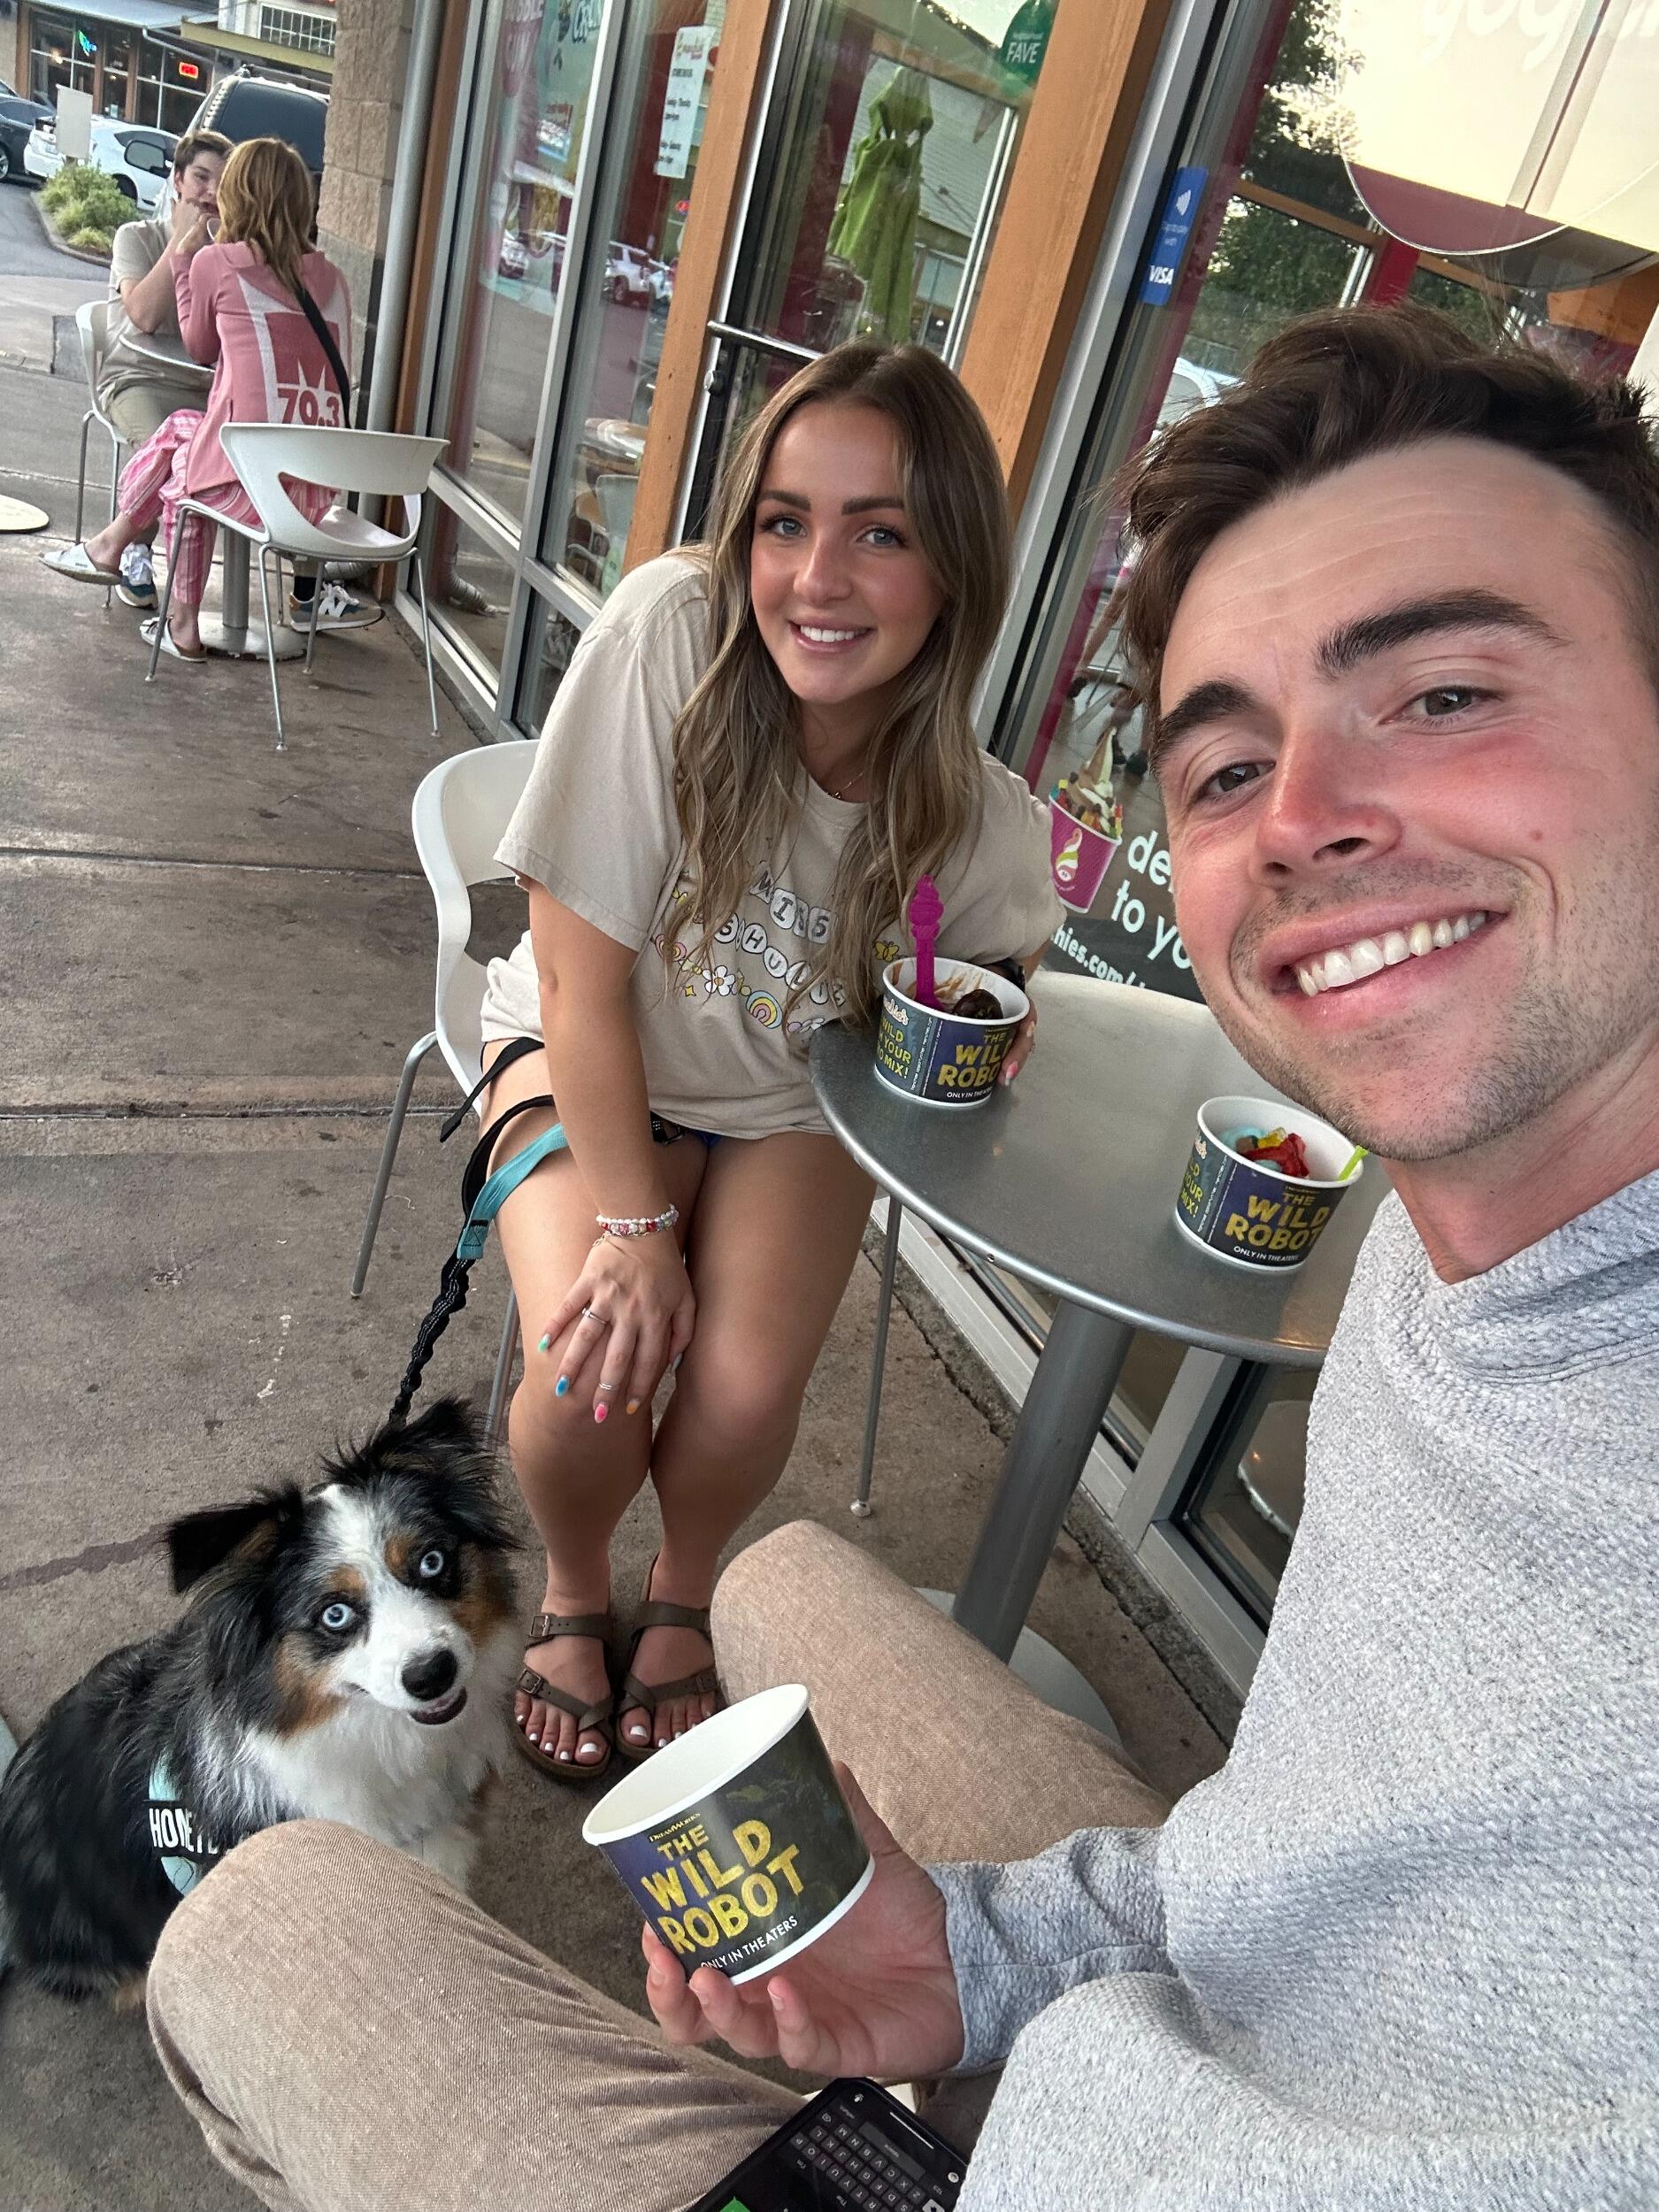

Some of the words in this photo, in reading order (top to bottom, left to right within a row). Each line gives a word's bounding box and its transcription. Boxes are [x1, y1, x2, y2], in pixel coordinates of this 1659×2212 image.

[1005, 42, 1041, 64] FAVE
[1149, 265, 1174, 284] VISA
[277, 388, 340, 427] 70.3
[1111, 879, 1145, 933] to
[885, 1035, 911, 1064] YOUR
[956, 1038, 1013, 1065] WIL
[984, 1033, 1006, 1044] THE
[885, 1054, 909, 1079] MIX!
[937, 1064, 1001, 1087] ROBO
[1248, 1194, 1330, 1228] WILD
[1282, 1193, 1316, 1206] THE
[1233, 1246, 1256, 1257] ONLY
[657, 1824, 709, 1862] THE
[641, 1819, 772, 1912] WILD
[657, 1844, 804, 1954] ROBOT
[727, 1948, 744, 1963] IN
[741, 1915, 798, 1955] THEATERS
